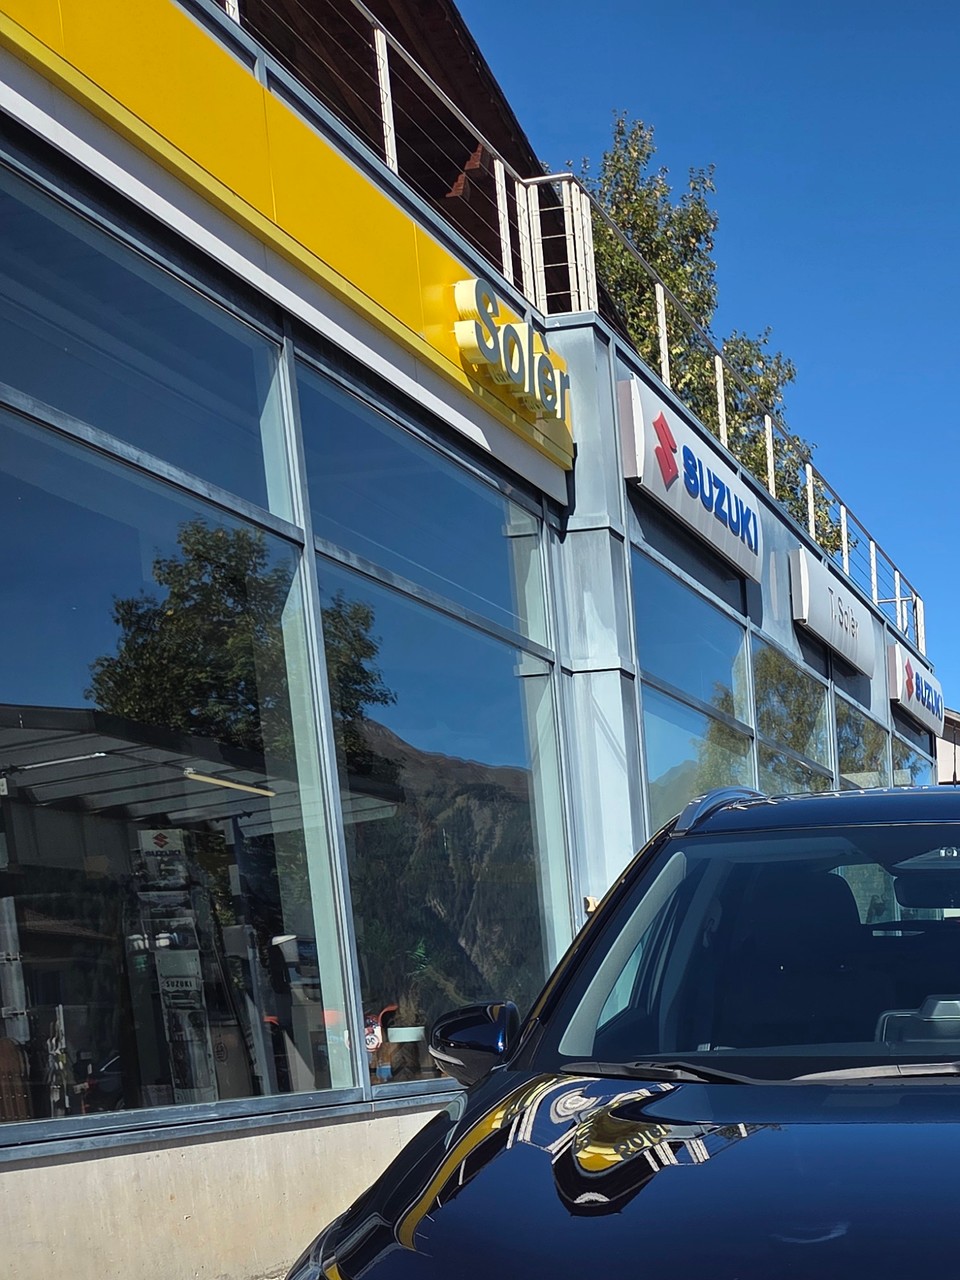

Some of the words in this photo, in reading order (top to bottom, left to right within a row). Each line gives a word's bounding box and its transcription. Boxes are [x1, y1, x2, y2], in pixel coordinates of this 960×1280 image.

[472, 278, 570, 421] Solèr
[682, 445, 759, 556] SUZUKI
[915, 672, 943, 722] SUZUKI
[166, 980, 192, 988] SUZUKI
